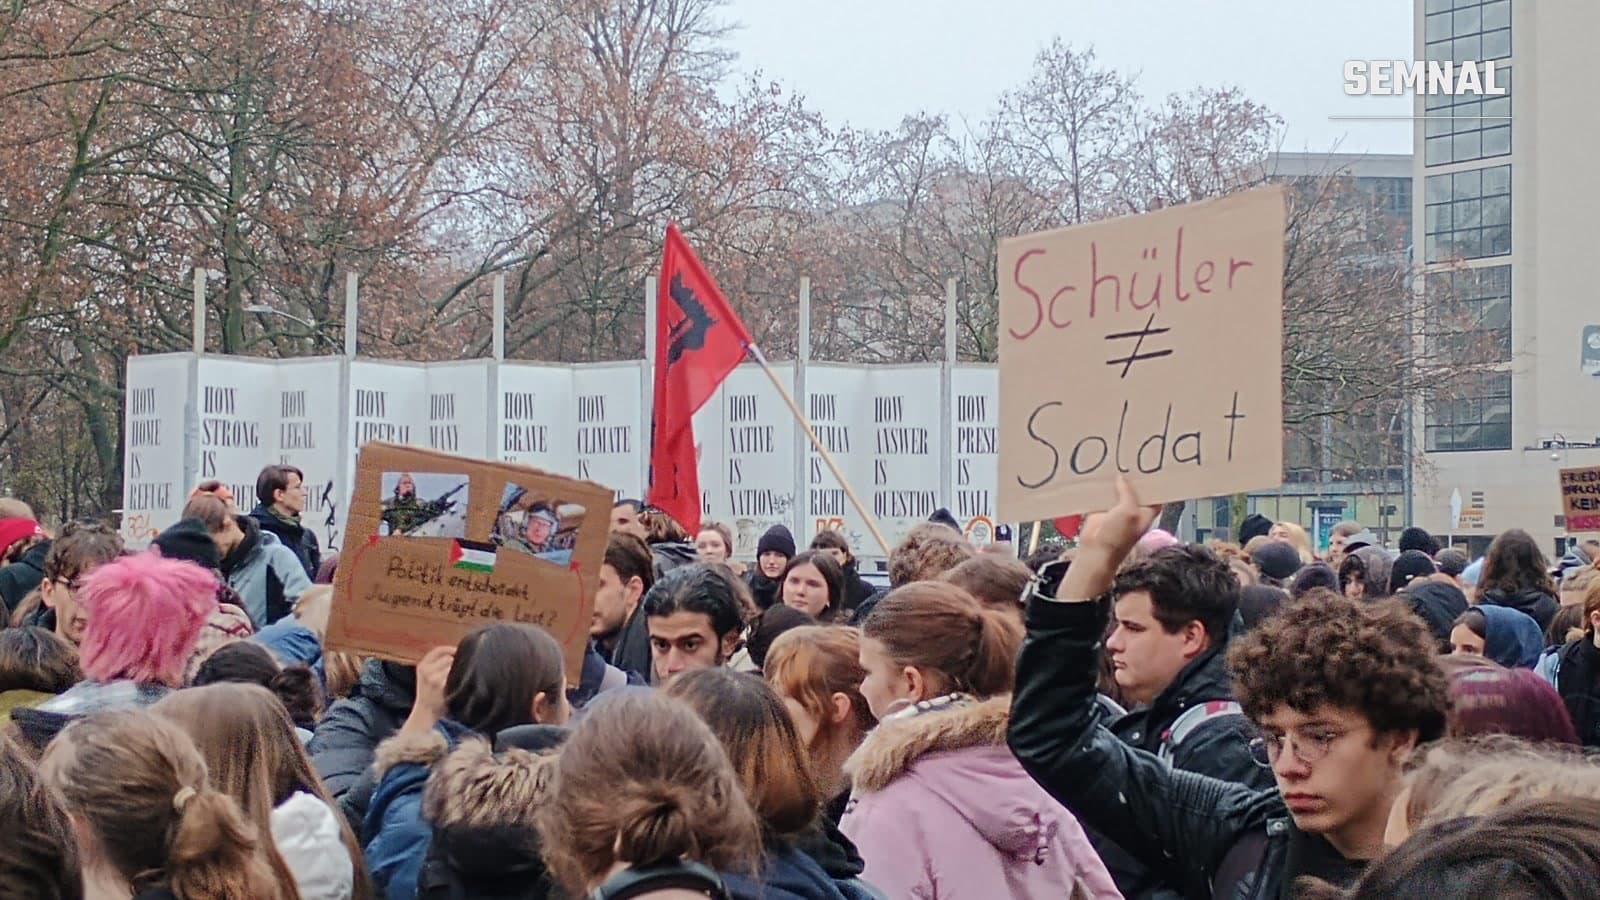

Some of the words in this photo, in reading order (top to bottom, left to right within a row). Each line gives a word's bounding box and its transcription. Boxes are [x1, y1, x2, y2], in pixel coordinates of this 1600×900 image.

[1009, 226, 1253, 339] Schüler
[132, 388, 157, 415] HOW
[205, 386, 236, 414] HOW
[282, 391, 306, 418] HOW
[355, 389, 388, 418] HOW
[430, 393, 456, 420] HOW
[504, 392, 536, 420] HOW
[578, 395, 607, 423] HOW
[730, 395, 758, 422] HOW
[811, 393, 838, 420] HOW
[875, 396, 904, 423] HOW
[958, 395, 987, 422] HOW
[131, 419, 161, 447] HOME
[202, 418, 259, 449] STRONG
[280, 422, 315, 450] LEGAL
[430, 424, 459, 452] MANY
[504, 425, 548, 452] BRAVE
[577, 425, 631, 454] CLIMATE
[730, 425, 774, 453] NATIVE
[811, 425, 850, 453] HUMAN
[875, 426, 928, 454] ANSWER
[1017, 391, 1246, 488] Soldat
[131, 451, 141, 479] IS
[202, 450, 216, 478] IS
[578, 459, 590, 480] IS
[730, 458, 741, 484] IS
[811, 457, 822, 484] IS
[875, 459, 887, 485] IS
[958, 459, 970, 485] IS
[129, 483, 172, 510] REFUGE
[729, 489, 774, 516] NATION
[811, 489, 846, 516] RIGHT
[874, 490, 938, 520] QUESTION
[958, 490, 991, 517] WALL
[387, 555, 442, 585] Politik
[366, 583, 433, 609] Jugend
[439, 595, 476, 619] trägt
[480, 602, 504, 620] die
[515, 603, 559, 627] Last?
